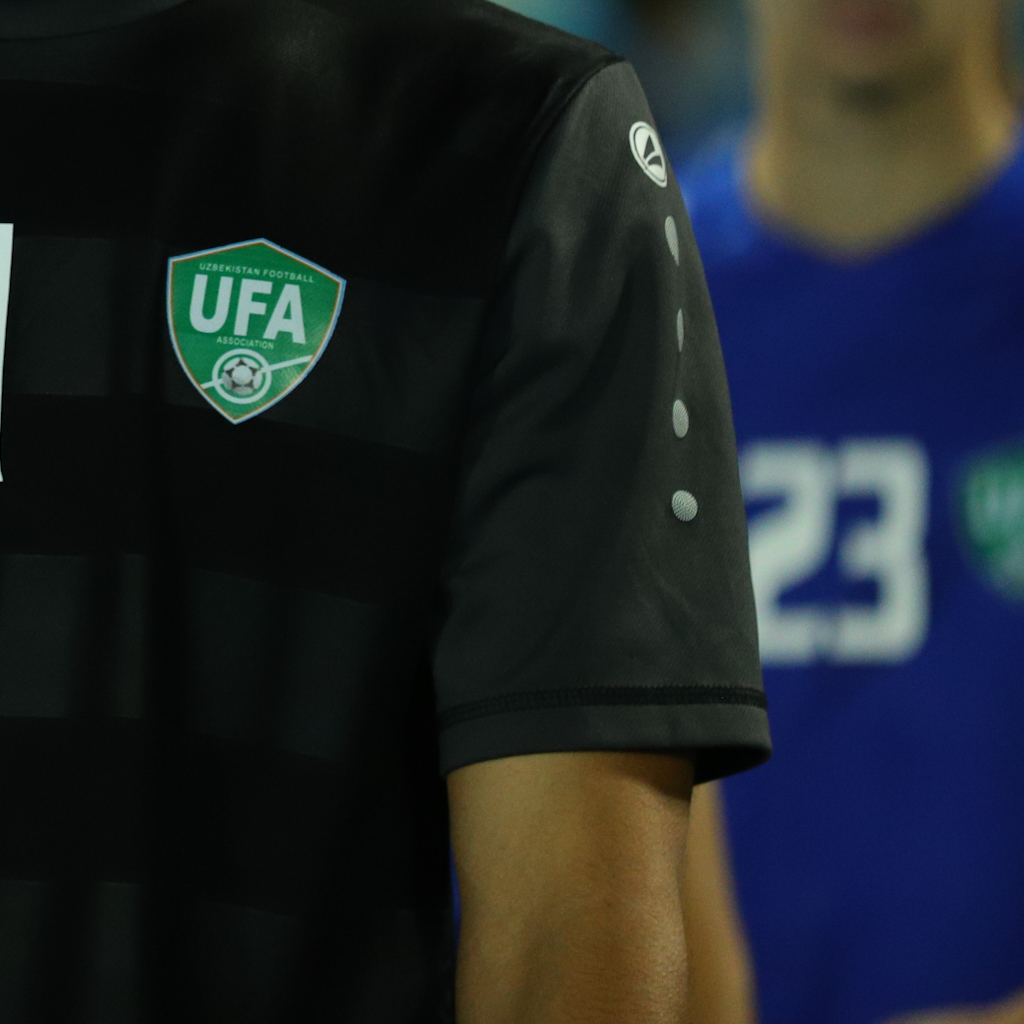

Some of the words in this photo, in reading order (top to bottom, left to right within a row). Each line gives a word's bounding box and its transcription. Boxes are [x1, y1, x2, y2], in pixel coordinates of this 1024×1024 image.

[199, 262, 261, 276] UZBEKISTAN
[262, 269, 315, 284] FOOTBALL
[189, 274, 307, 345] UFA
[216, 336, 275, 350] ASSOCIATION
[740, 438, 930, 666] 23
